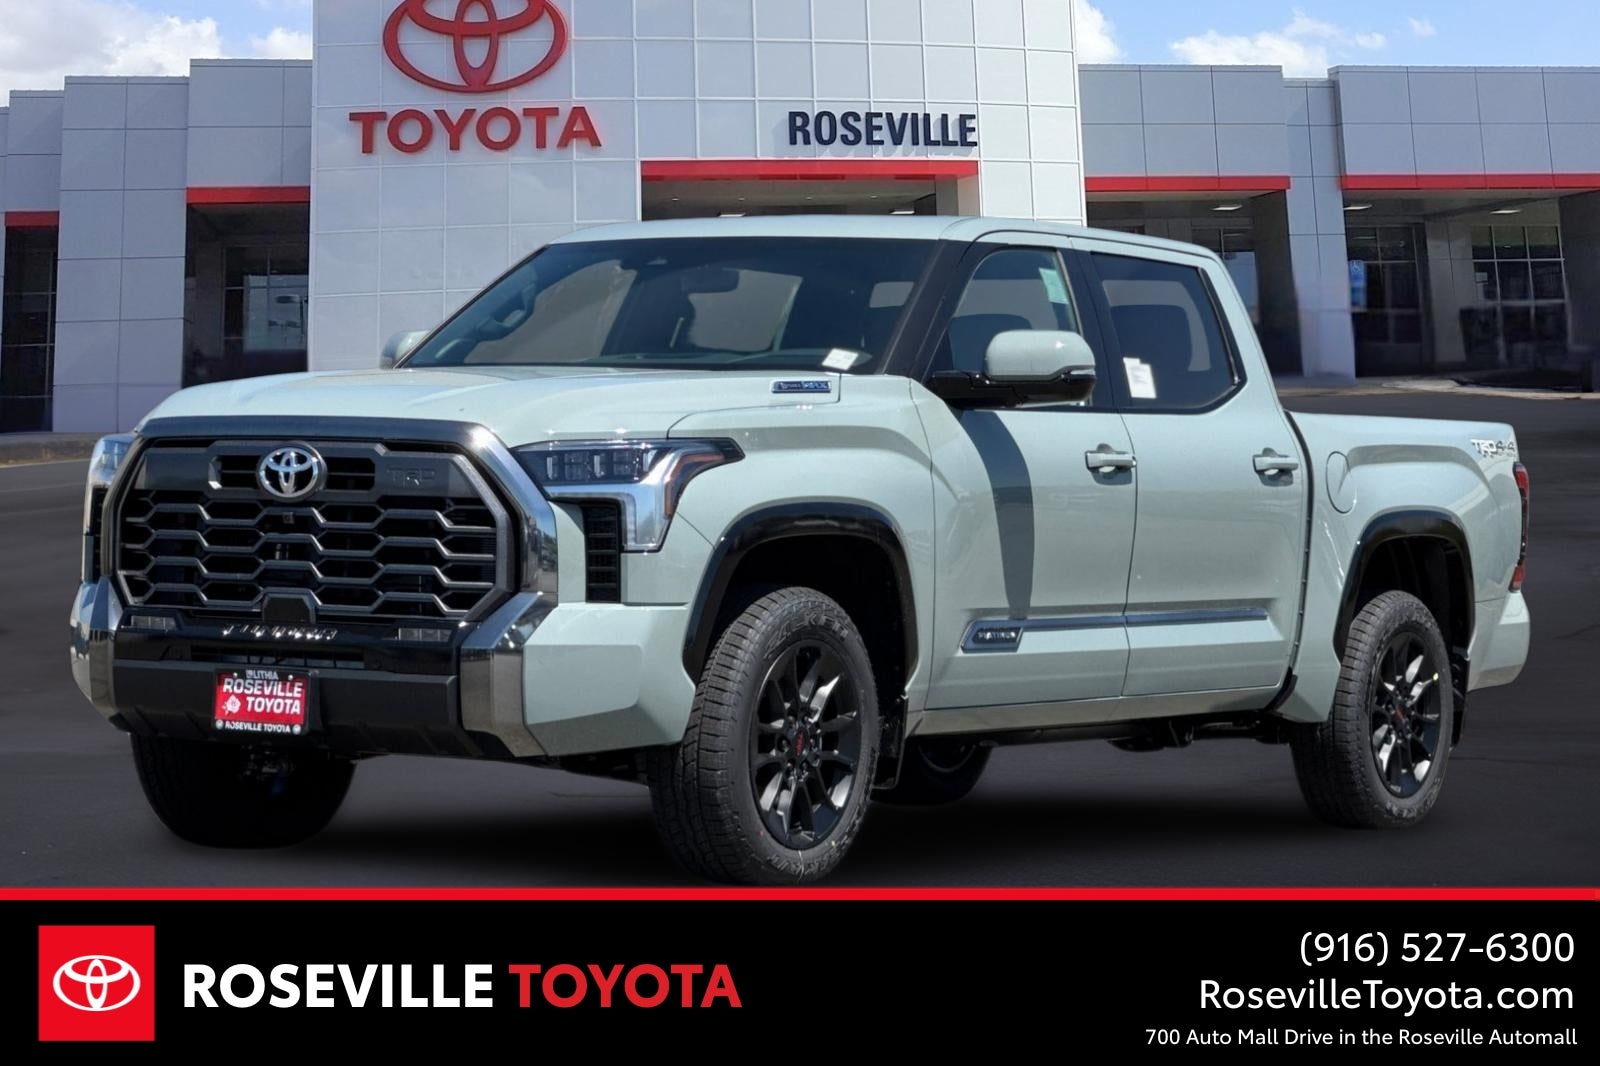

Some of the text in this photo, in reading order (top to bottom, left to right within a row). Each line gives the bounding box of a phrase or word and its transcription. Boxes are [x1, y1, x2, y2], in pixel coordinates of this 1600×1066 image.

[349, 106, 602, 154] TOYOTA
[788, 111, 978, 147] ROSEVILLE
[253, 670, 279, 680] LITHIA
[222, 678, 303, 698] ROSEVILLE
[246, 696, 301, 715] TOYOTA
[225, 722, 291, 733] ROSEVILLE TOYOTA
